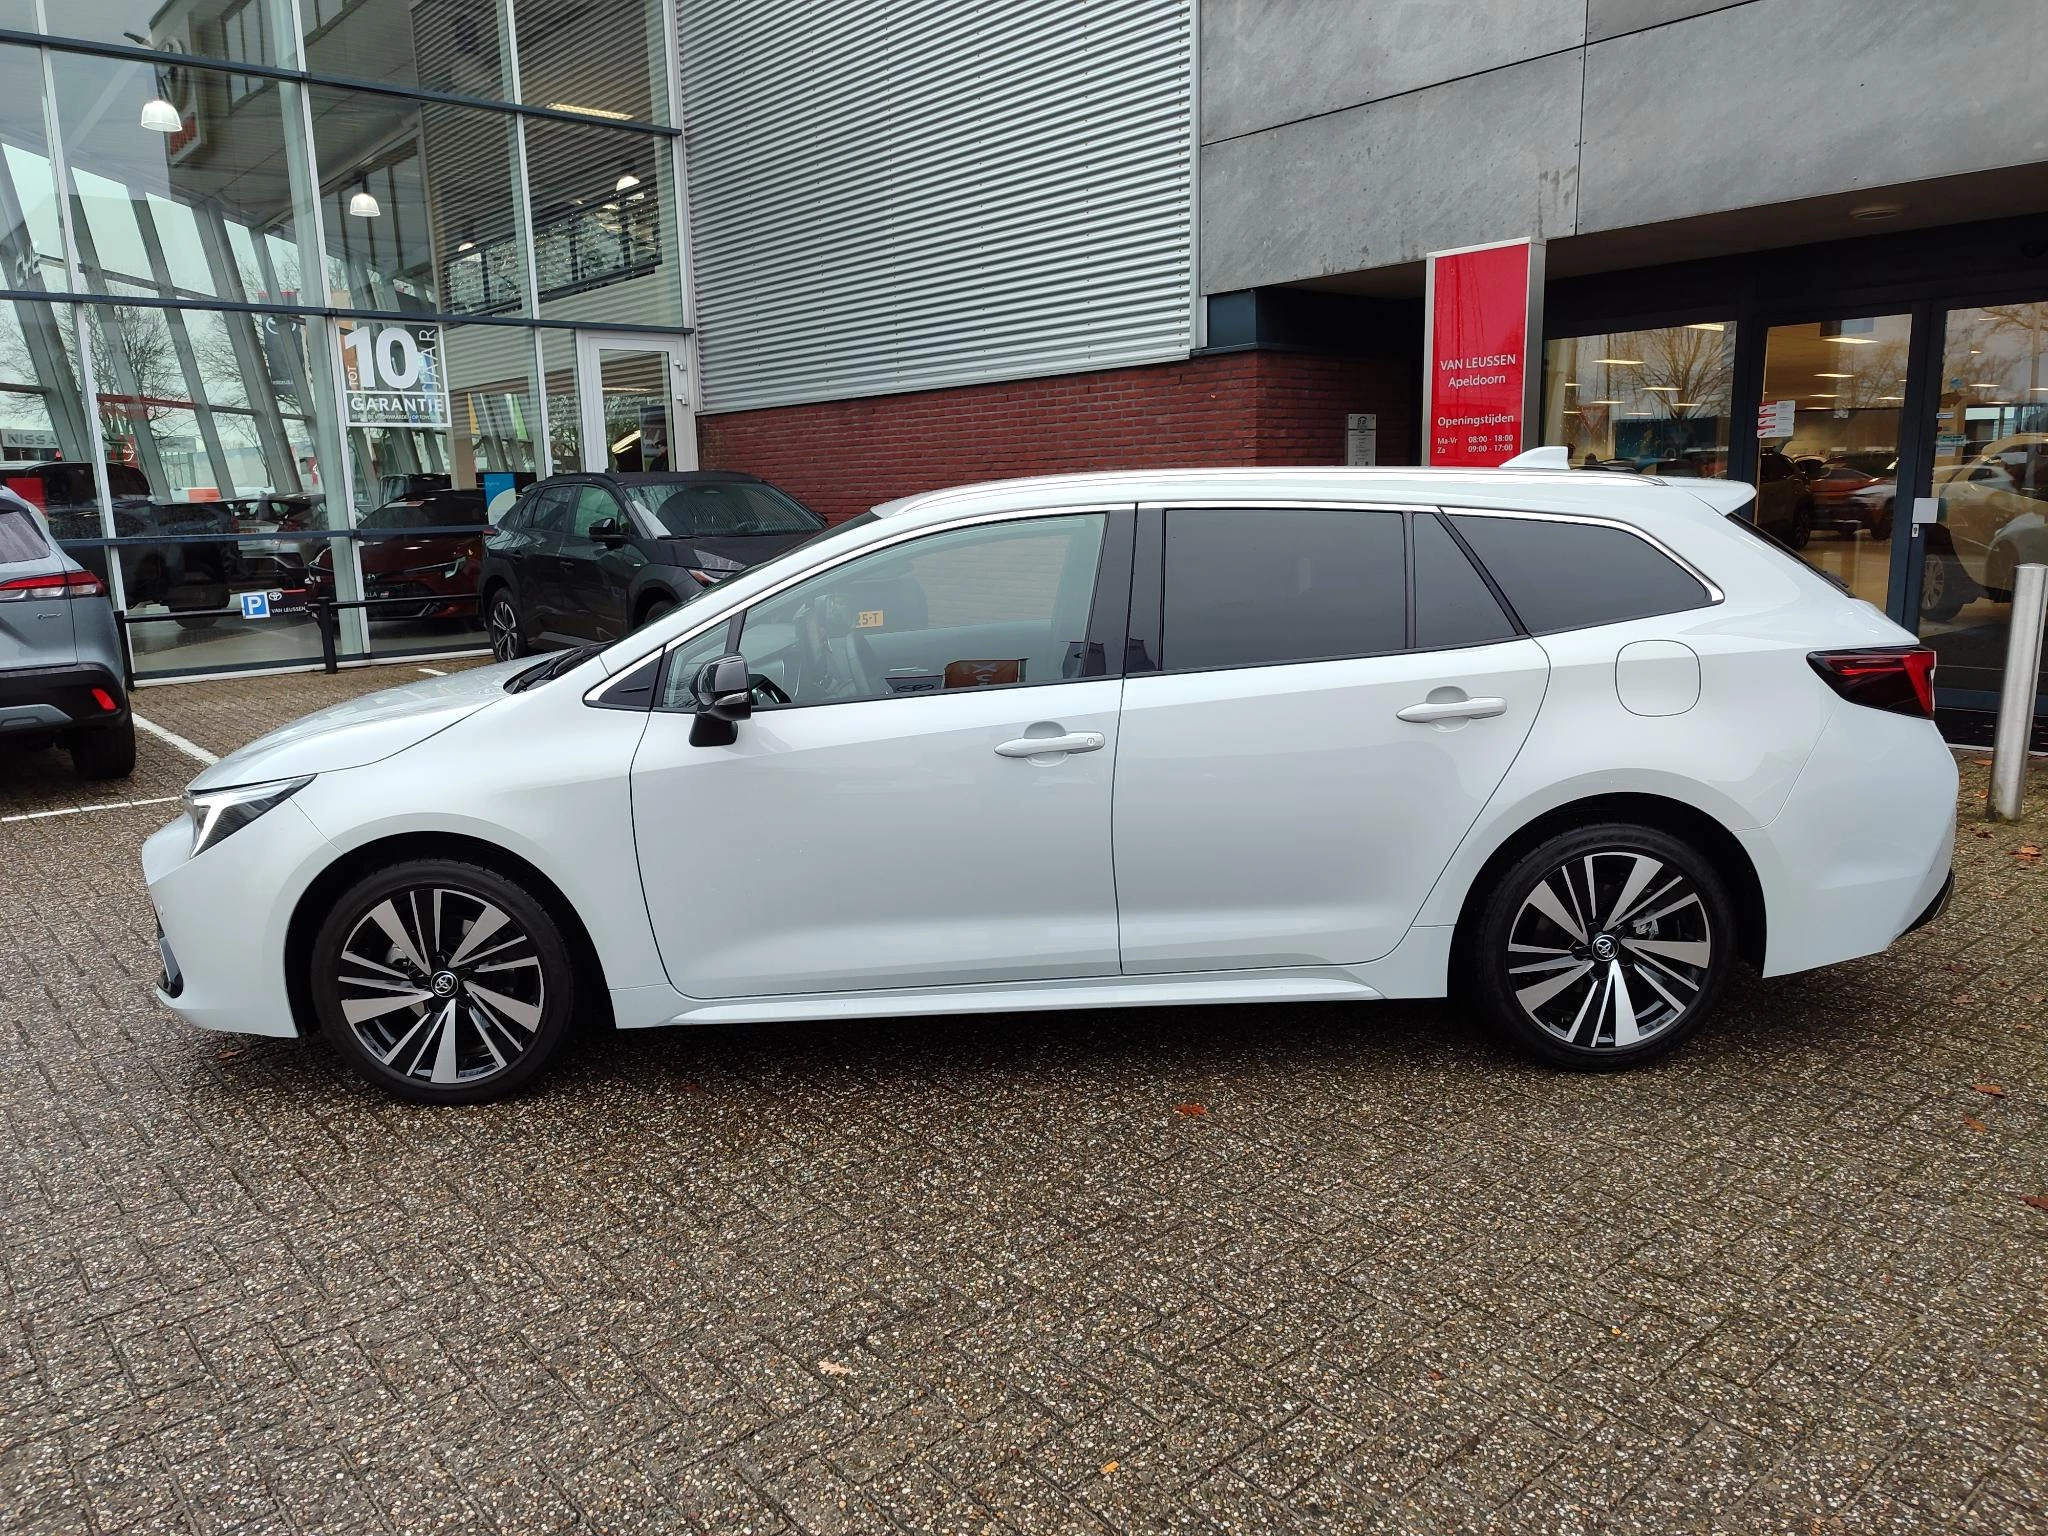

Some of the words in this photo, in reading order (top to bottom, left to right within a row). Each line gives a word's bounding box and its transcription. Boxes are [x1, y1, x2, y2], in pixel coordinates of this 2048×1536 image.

[344, 326, 421, 389] 10
[418, 329, 441, 390] JAAR
[1440, 359, 1463, 371] VAN
[1466, 354, 1516, 369] LEUSSEN
[347, 365, 359, 387] TOT
[1448, 374, 1506, 390] Apeldoorn
[350, 397, 445, 412] GARANTIE
[1437, 413, 1514, 428] Openingstijden
[7, 432, 57, 445] NISSA
[1437, 437, 1458, 445] Ma-Vr
[1468, 435, 1488, 443] 08:00
[1494, 434, 1514, 442] 18:00
[1468, 445, 1487, 453] 09:00
[1494, 444, 1513, 452] 17:00
[247, 596, 262, 615] P
[283, 605, 306, 613] LEUSSEN
